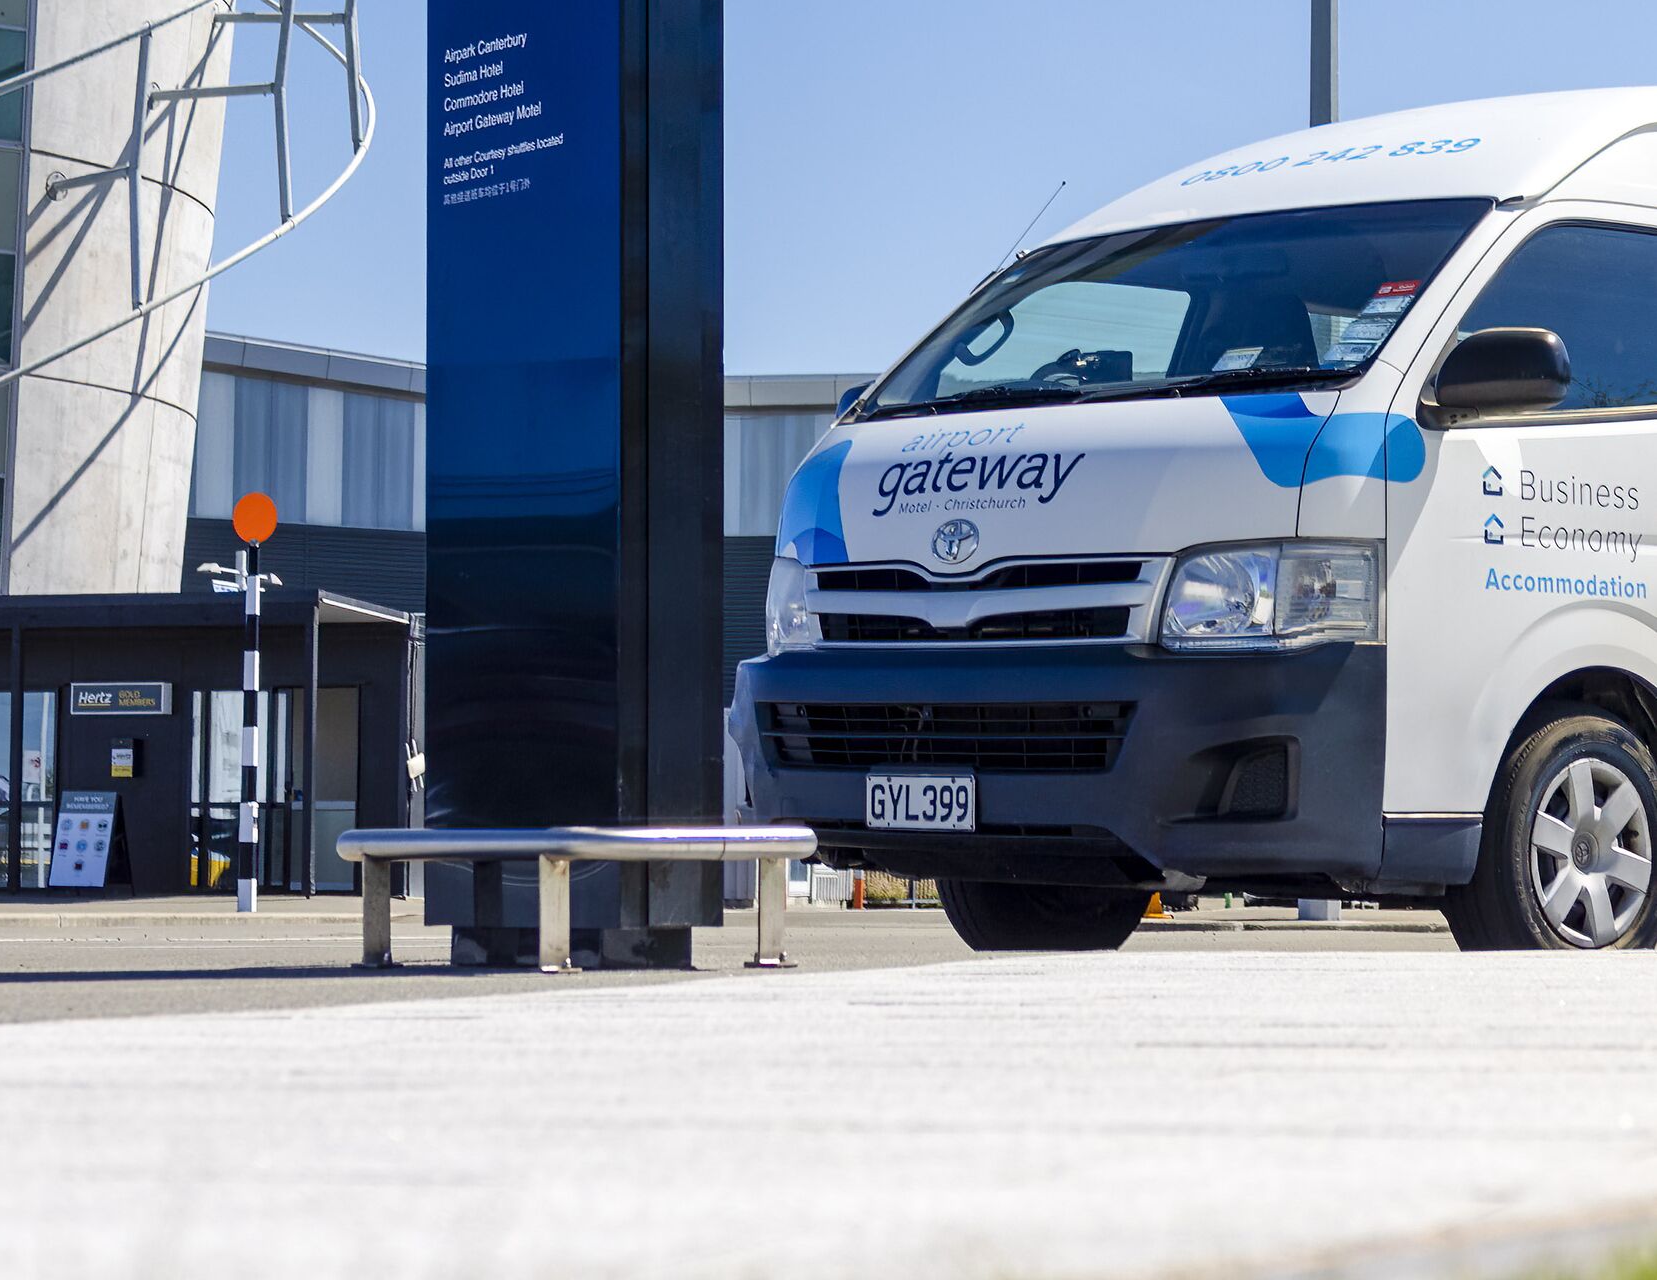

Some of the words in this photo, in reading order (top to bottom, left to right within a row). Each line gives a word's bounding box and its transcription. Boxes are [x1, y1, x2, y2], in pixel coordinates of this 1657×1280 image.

[444, 43, 476, 64] Airpark
[477, 32, 528, 55] Canterbury
[444, 70, 478, 88] Sudima
[479, 60, 503, 80] Hotel
[444, 89, 498, 112] Commodore
[500, 80, 524, 99] Hotel
[443, 118, 474, 138] Airport
[474, 111, 515, 130] Gateway
[516, 100, 542, 120] Motel
[454, 154, 473, 168] other
[474, 148, 507, 163] Courtesy
[507, 141, 536, 156] shuttles
[536, 133, 564, 149] located
[1180, 156, 1290, 186] 0800
[1292, 144, 1383, 167] 242
[1388, 137, 1481, 157] 839
[470, 167, 488, 180] Door
[901, 423, 1026, 453] airport
[872, 452, 1086, 517] gateway
[1520, 470, 1639, 510] Business
[898, 500, 932, 515] Motel
[944, 496, 1026, 512] Christchurch
[1521, 516, 1643, 563] Economy
[1485, 567, 1648, 599] Accommodation
[78, 691, 113, 704] Hertz
[870, 784, 969, 822] GYL399
